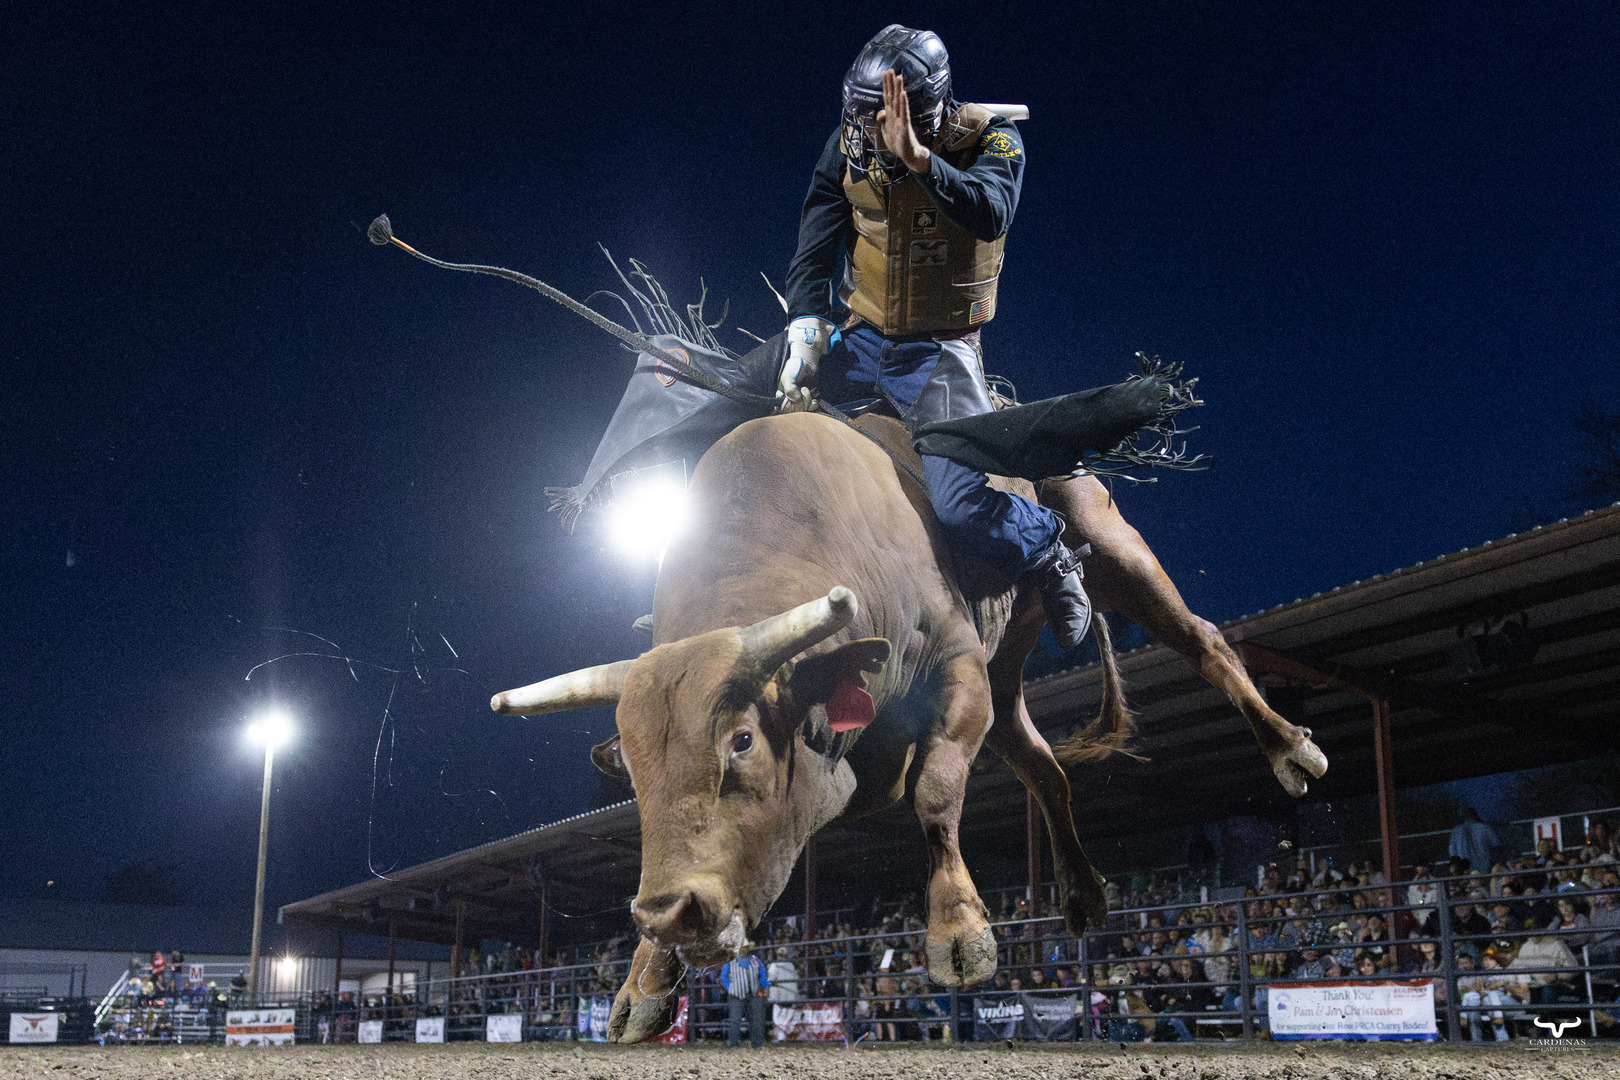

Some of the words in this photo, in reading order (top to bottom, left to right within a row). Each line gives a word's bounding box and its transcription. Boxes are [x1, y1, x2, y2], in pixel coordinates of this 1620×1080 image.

[190, 967, 202, 979] M
[1322, 989, 1351, 1001] Thank
[978, 1001, 1024, 1019] VIKING
